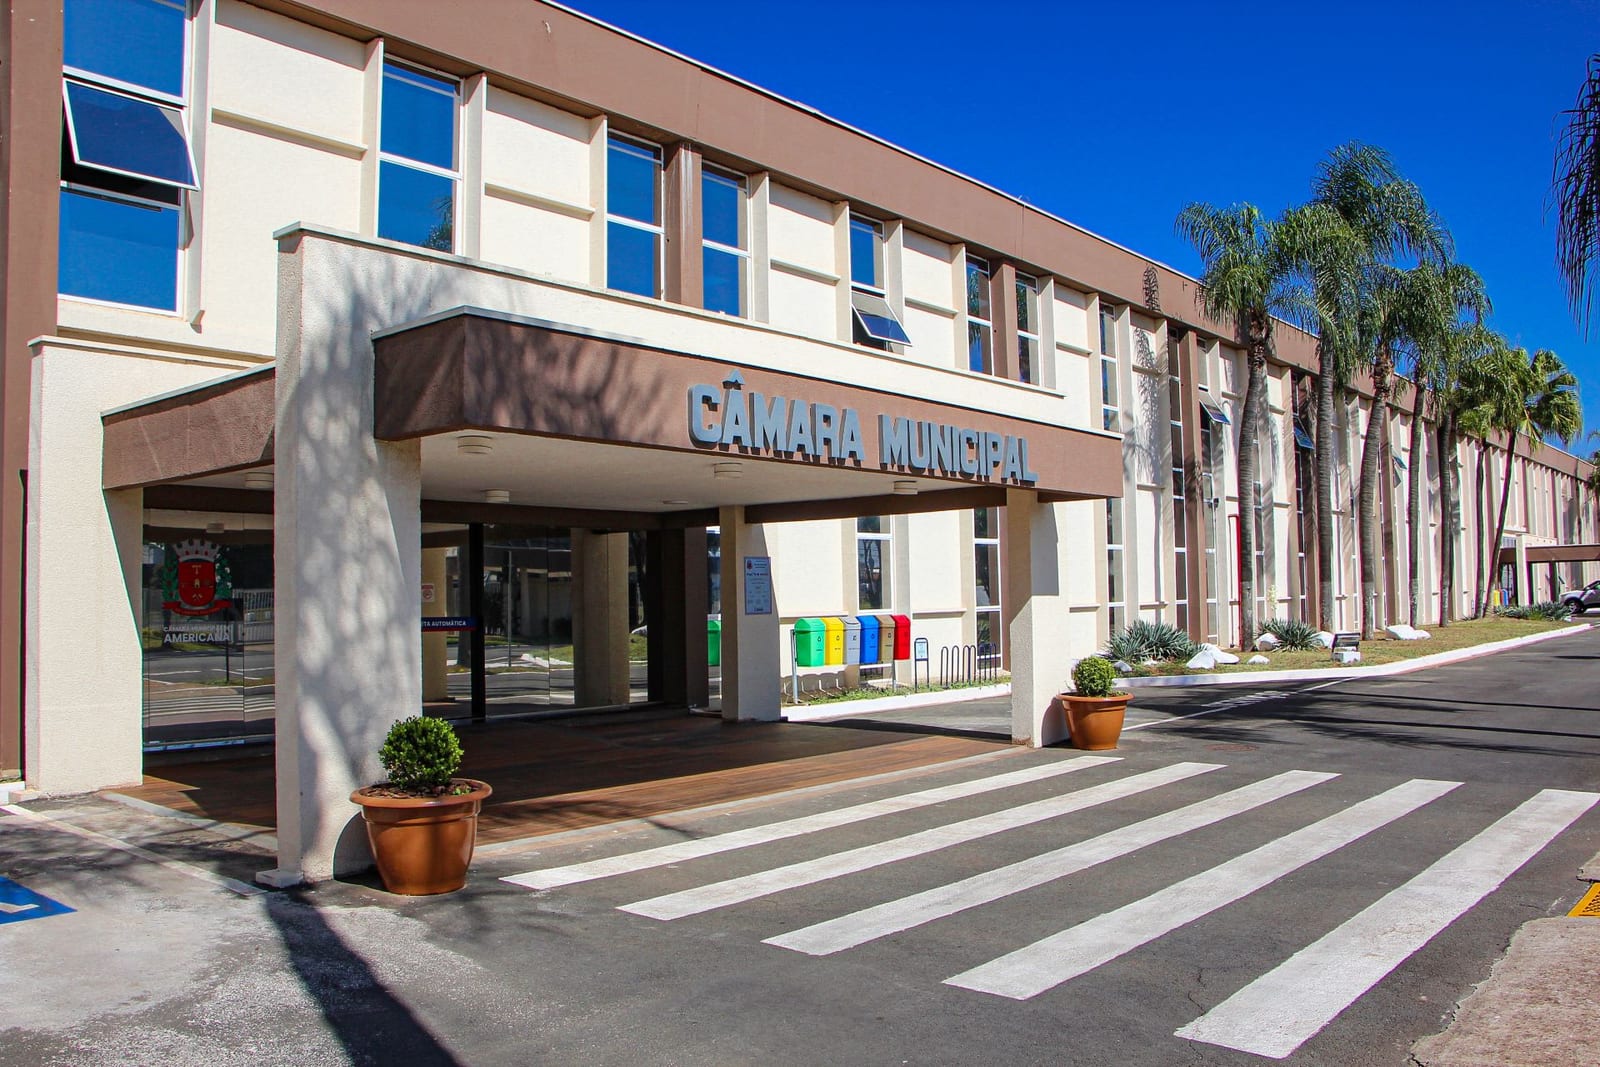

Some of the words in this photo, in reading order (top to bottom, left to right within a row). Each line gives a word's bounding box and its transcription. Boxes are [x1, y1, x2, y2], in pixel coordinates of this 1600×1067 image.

[688, 369, 865, 460] CÂMARA
[878, 414, 1039, 484] MUNICIPAL
[163, 633, 230, 643] AMERICANA
